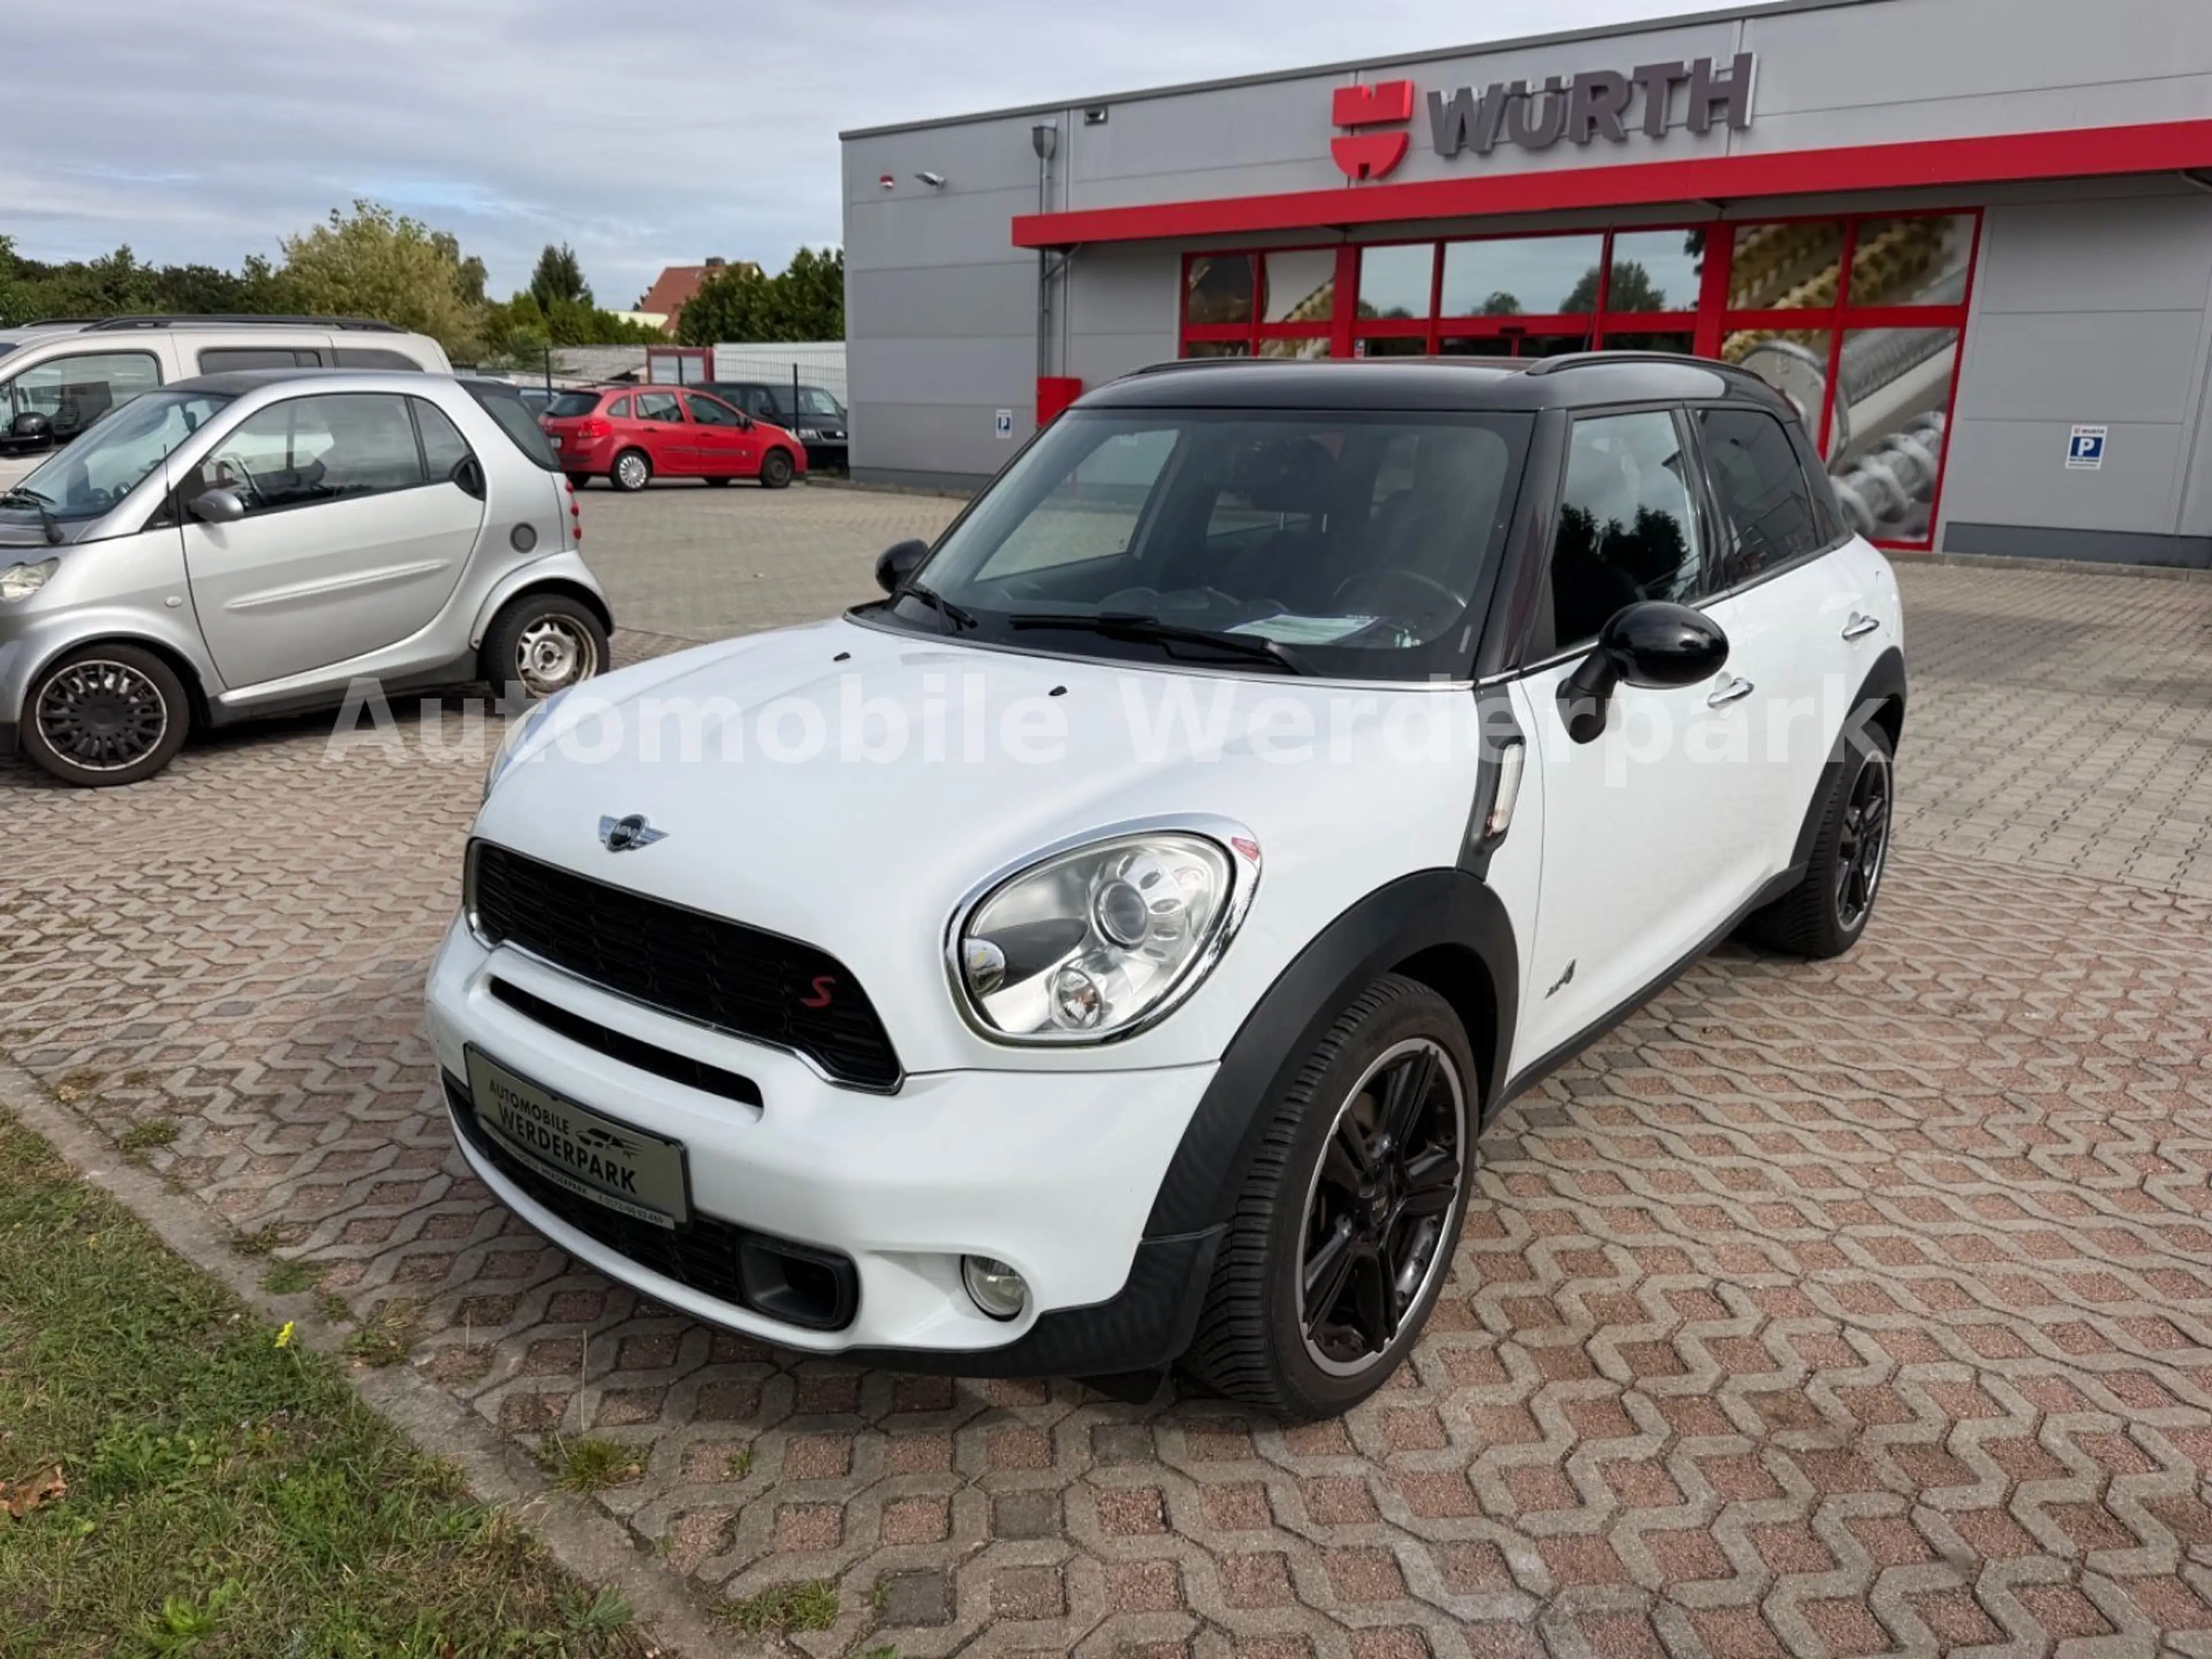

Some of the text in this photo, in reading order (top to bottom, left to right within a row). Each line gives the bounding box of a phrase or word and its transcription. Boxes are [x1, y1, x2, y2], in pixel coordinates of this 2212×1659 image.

[1427, 52, 1758, 157] WÜRTH
[1001, 416, 1007, 430] P
[2077, 438, 2095, 456] P
[800, 975, 836, 1007] S
[489, 1079, 571, 1136] AUTOMOBILE
[498, 1103, 638, 1195] WERDERPARK
